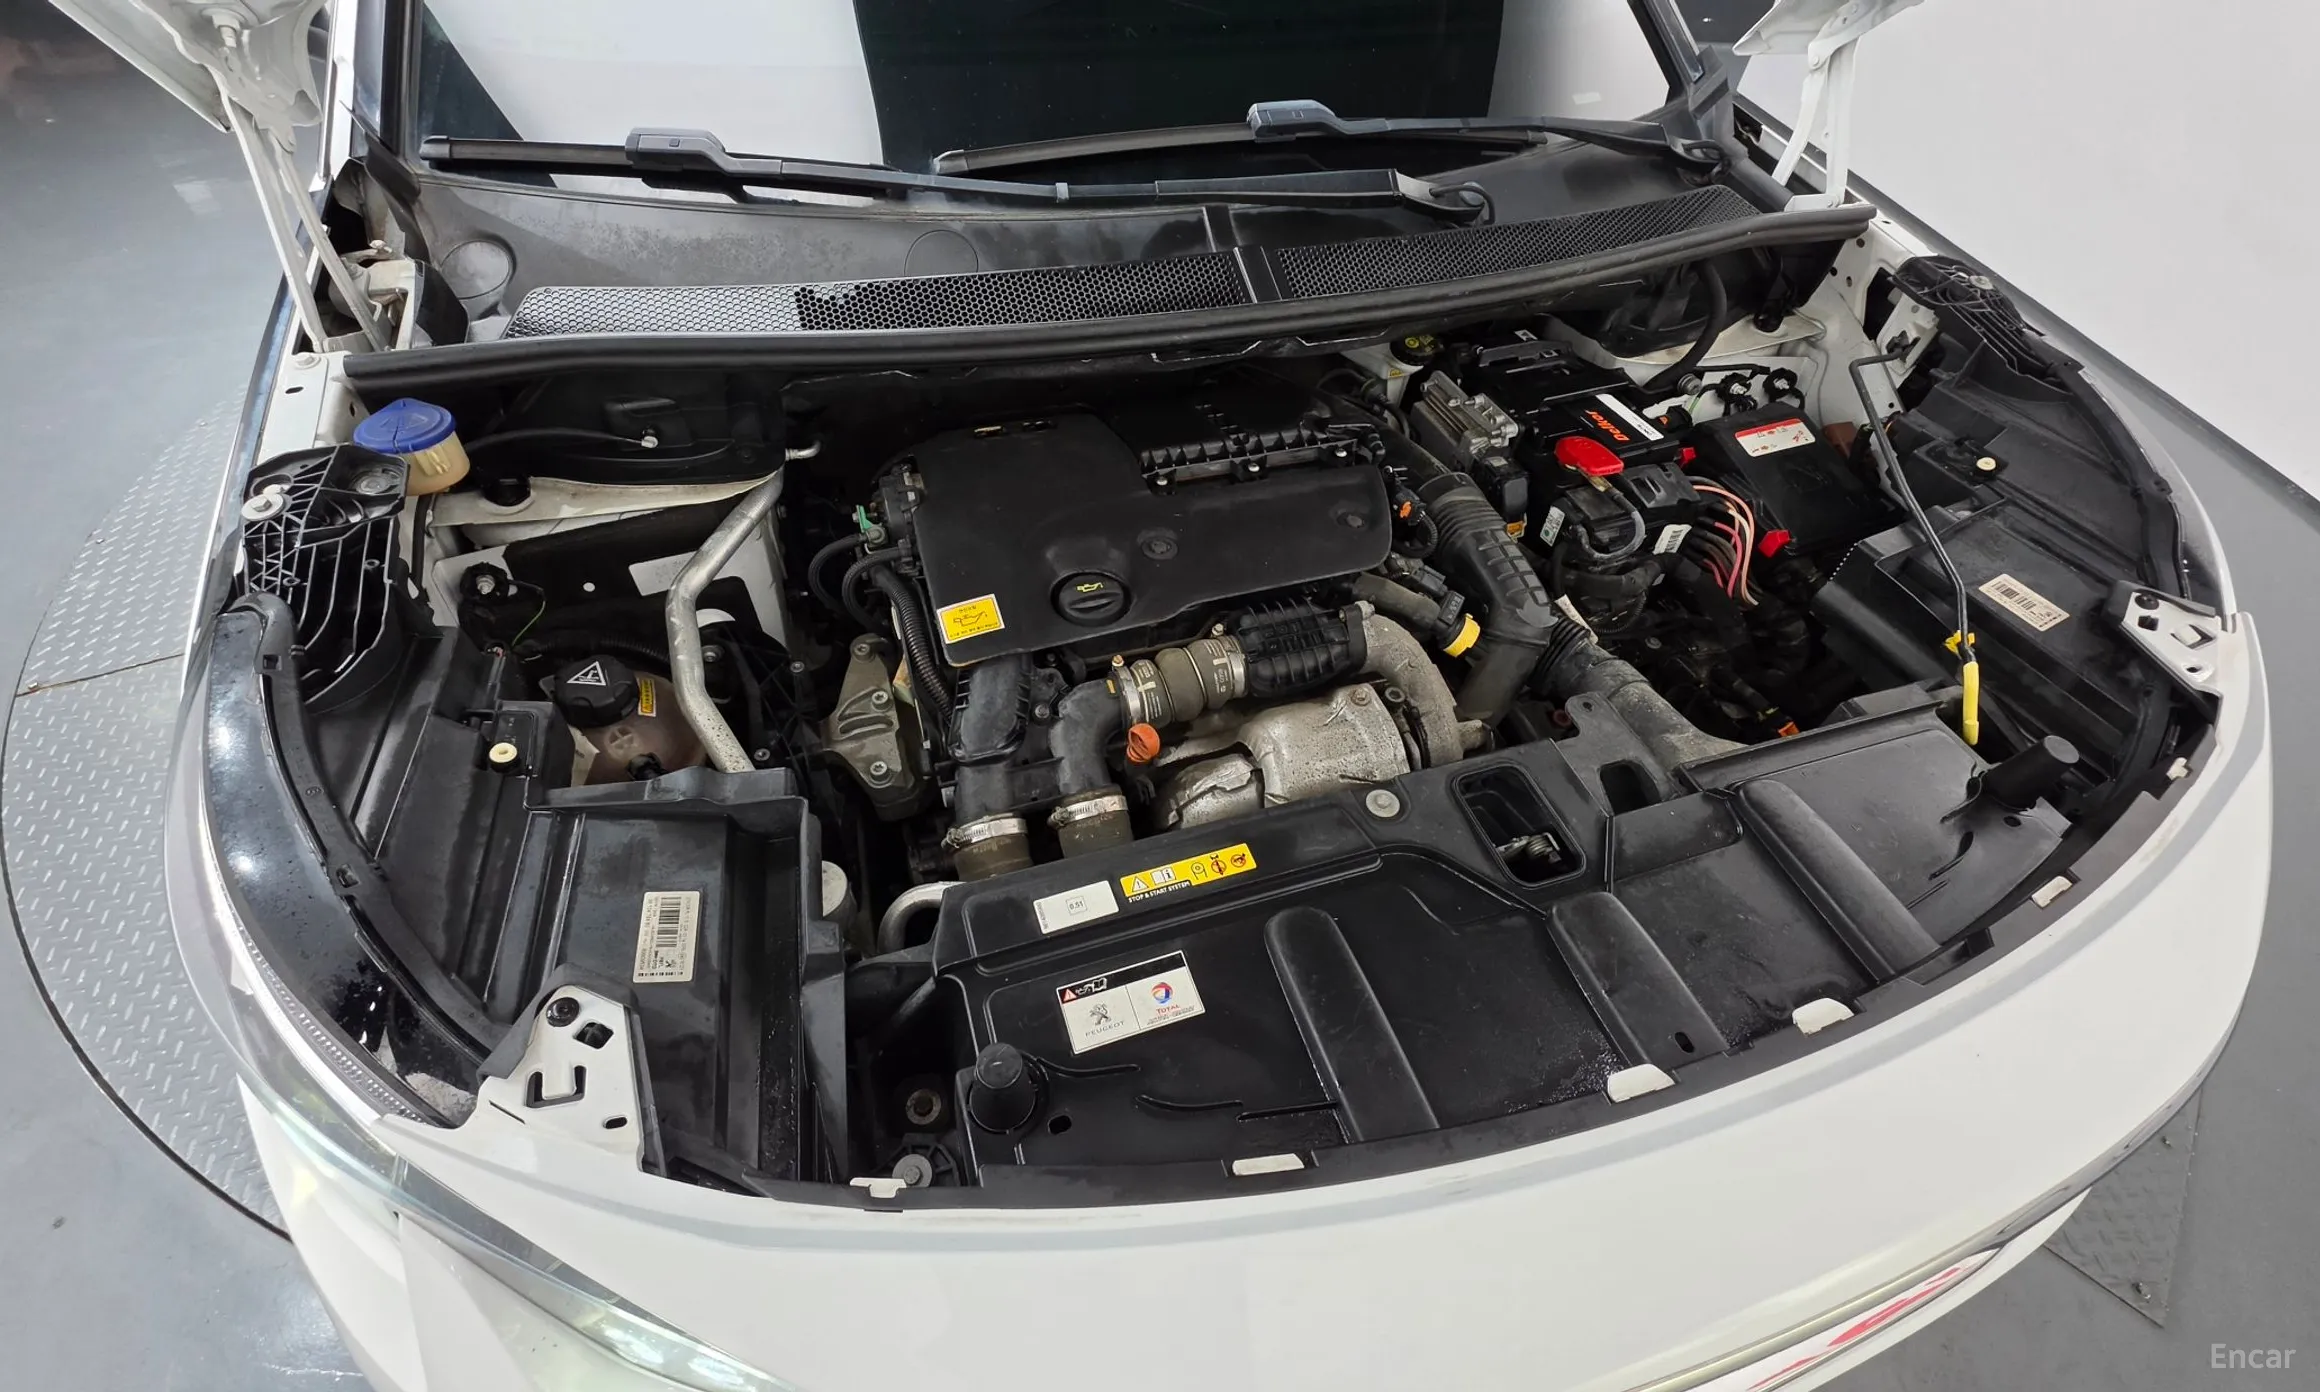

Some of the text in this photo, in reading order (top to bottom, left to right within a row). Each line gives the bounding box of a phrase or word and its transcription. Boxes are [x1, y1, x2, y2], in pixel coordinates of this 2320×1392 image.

[1584, 409, 1630, 441] Delkor
[1128, 893, 1144, 903] STOP
[1149, 887, 1167, 897] START
[1167, 881, 1190, 891] SYSTEM
[1156, 1004, 1181, 1014] TOTAL
[1085, 1021, 1125, 1037] PEUGEOT
